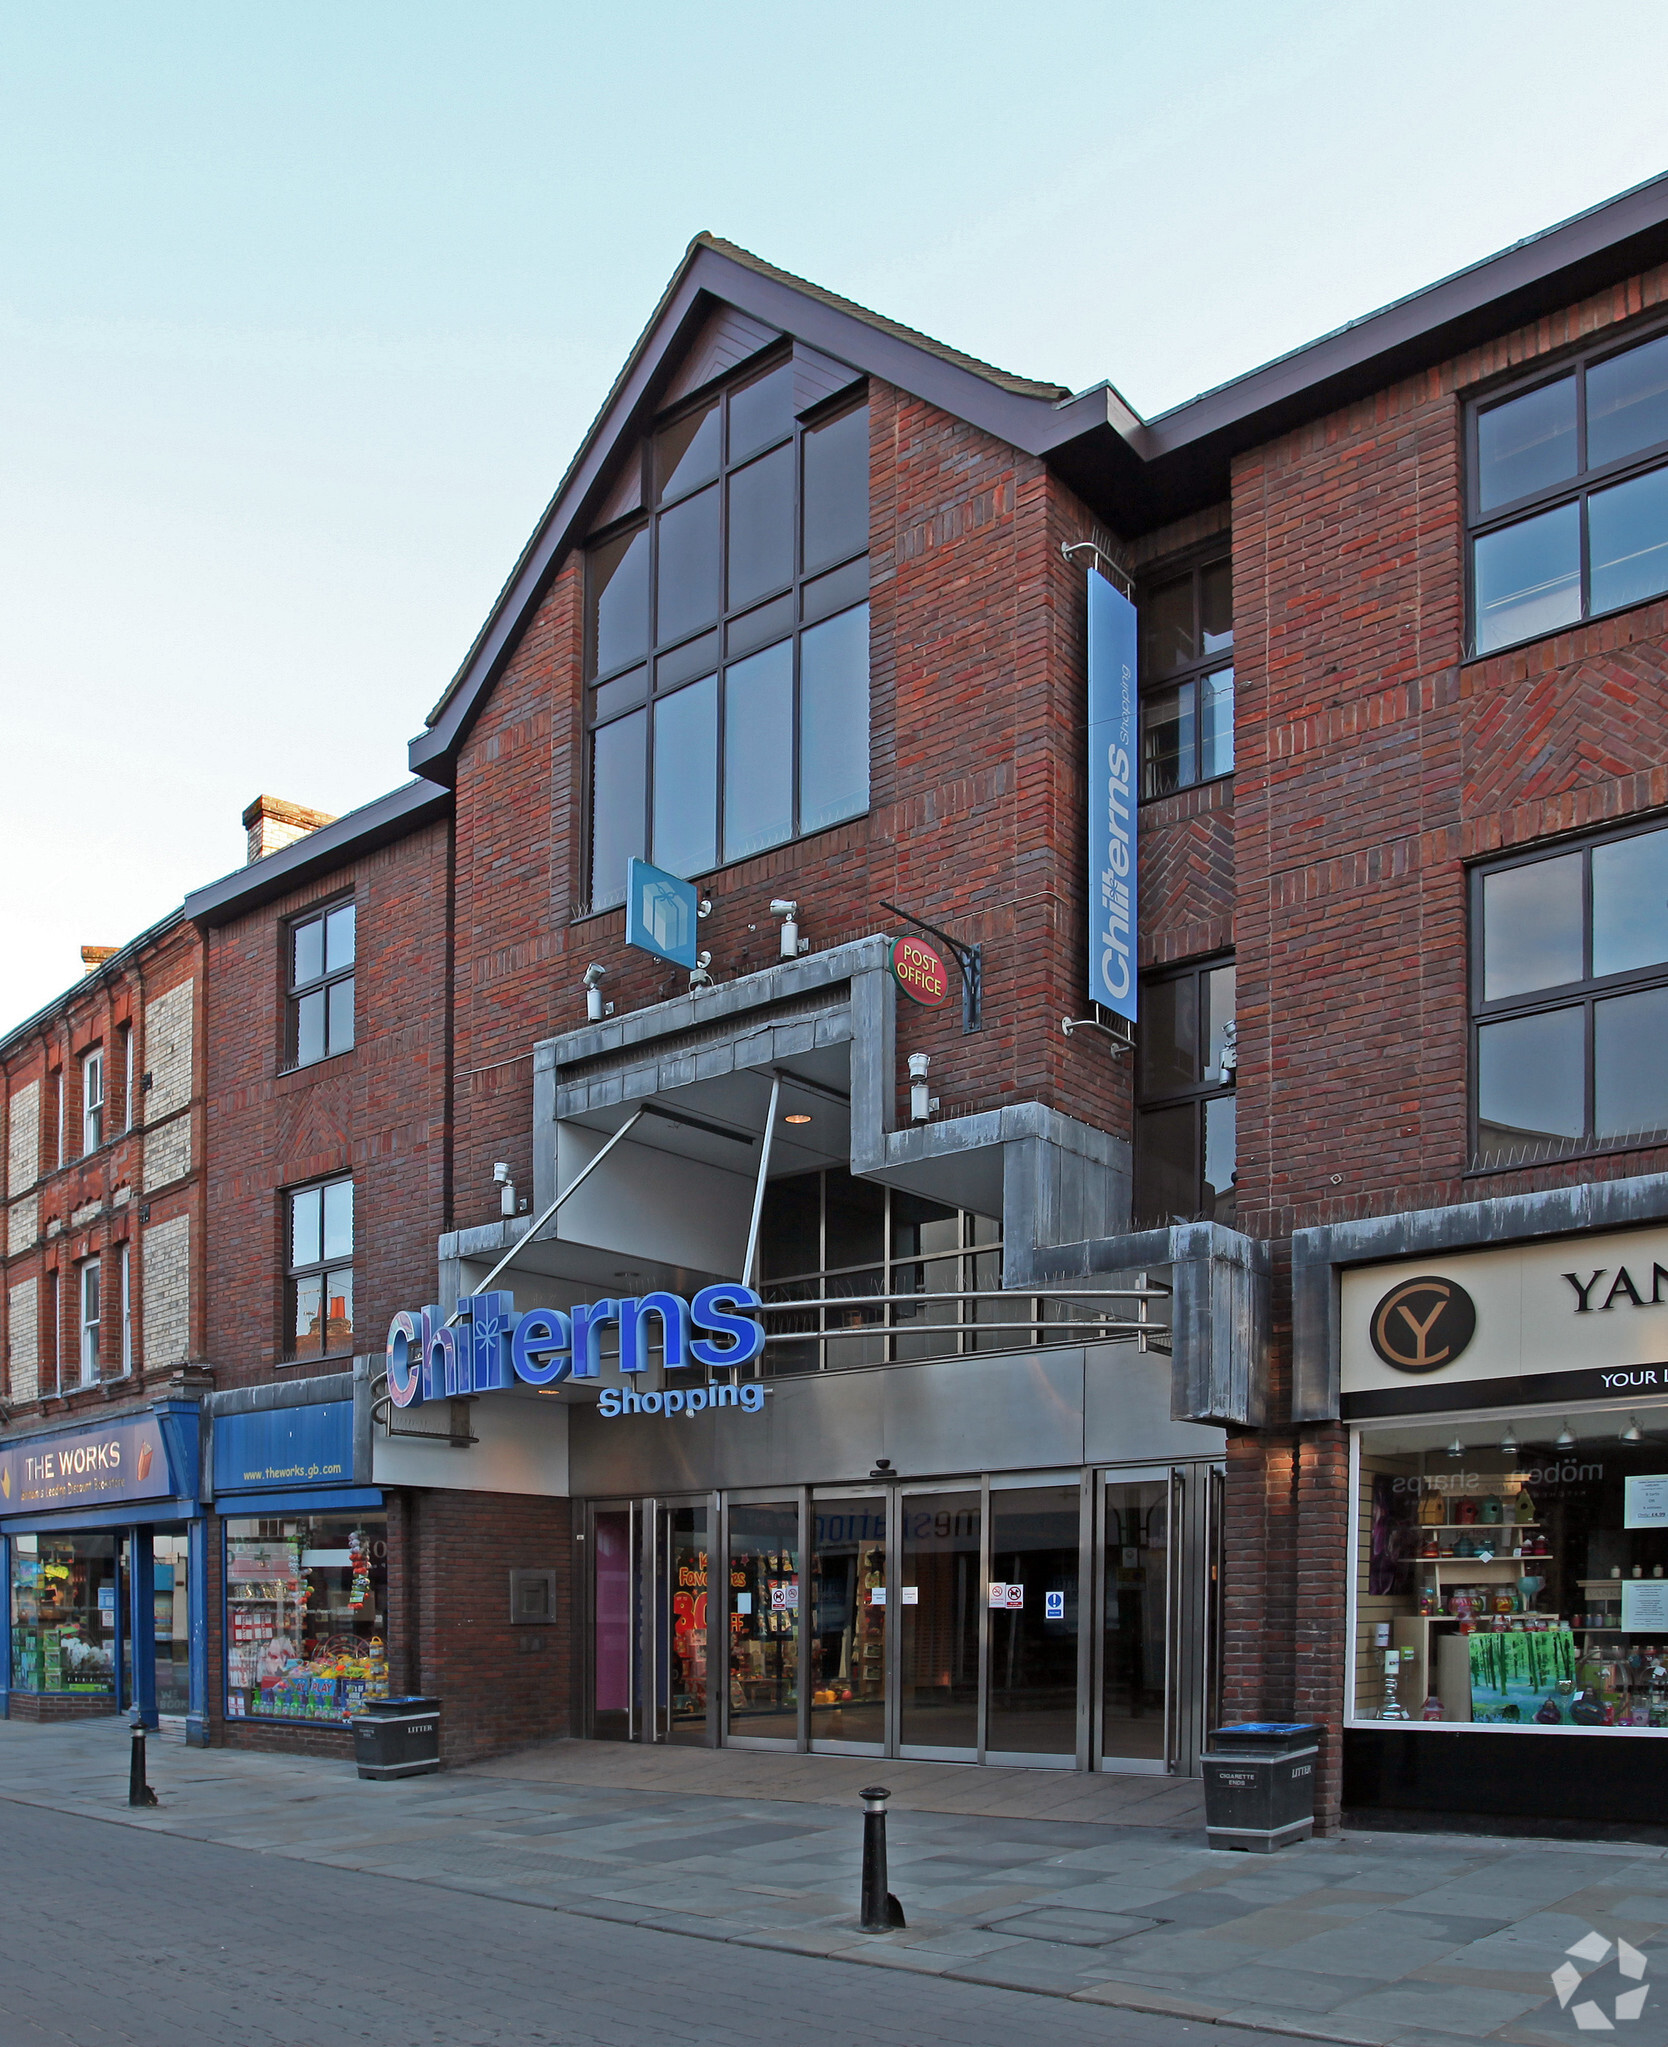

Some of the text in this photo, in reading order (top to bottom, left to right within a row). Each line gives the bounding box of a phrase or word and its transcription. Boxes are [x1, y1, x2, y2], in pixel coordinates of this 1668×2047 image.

[1102, 664, 1130, 999] Chilterns Shopping
[904, 944, 938, 974] POST
[897, 962, 942, 997] OFFICE
[386, 1283, 765, 1408] Chilterns
[1601, 1370, 1658, 1388] YOUR
[599, 1379, 764, 1419] Shopping
[25, 1441, 121, 1480] THE WORKS
[243, 1463, 342, 1480] www.theworks.gb.com
[312, 1683, 332, 1693] PLAY
[407, 1724, 433, 1734] LITTER
[1291, 1765, 1311, 1778] LITTER
